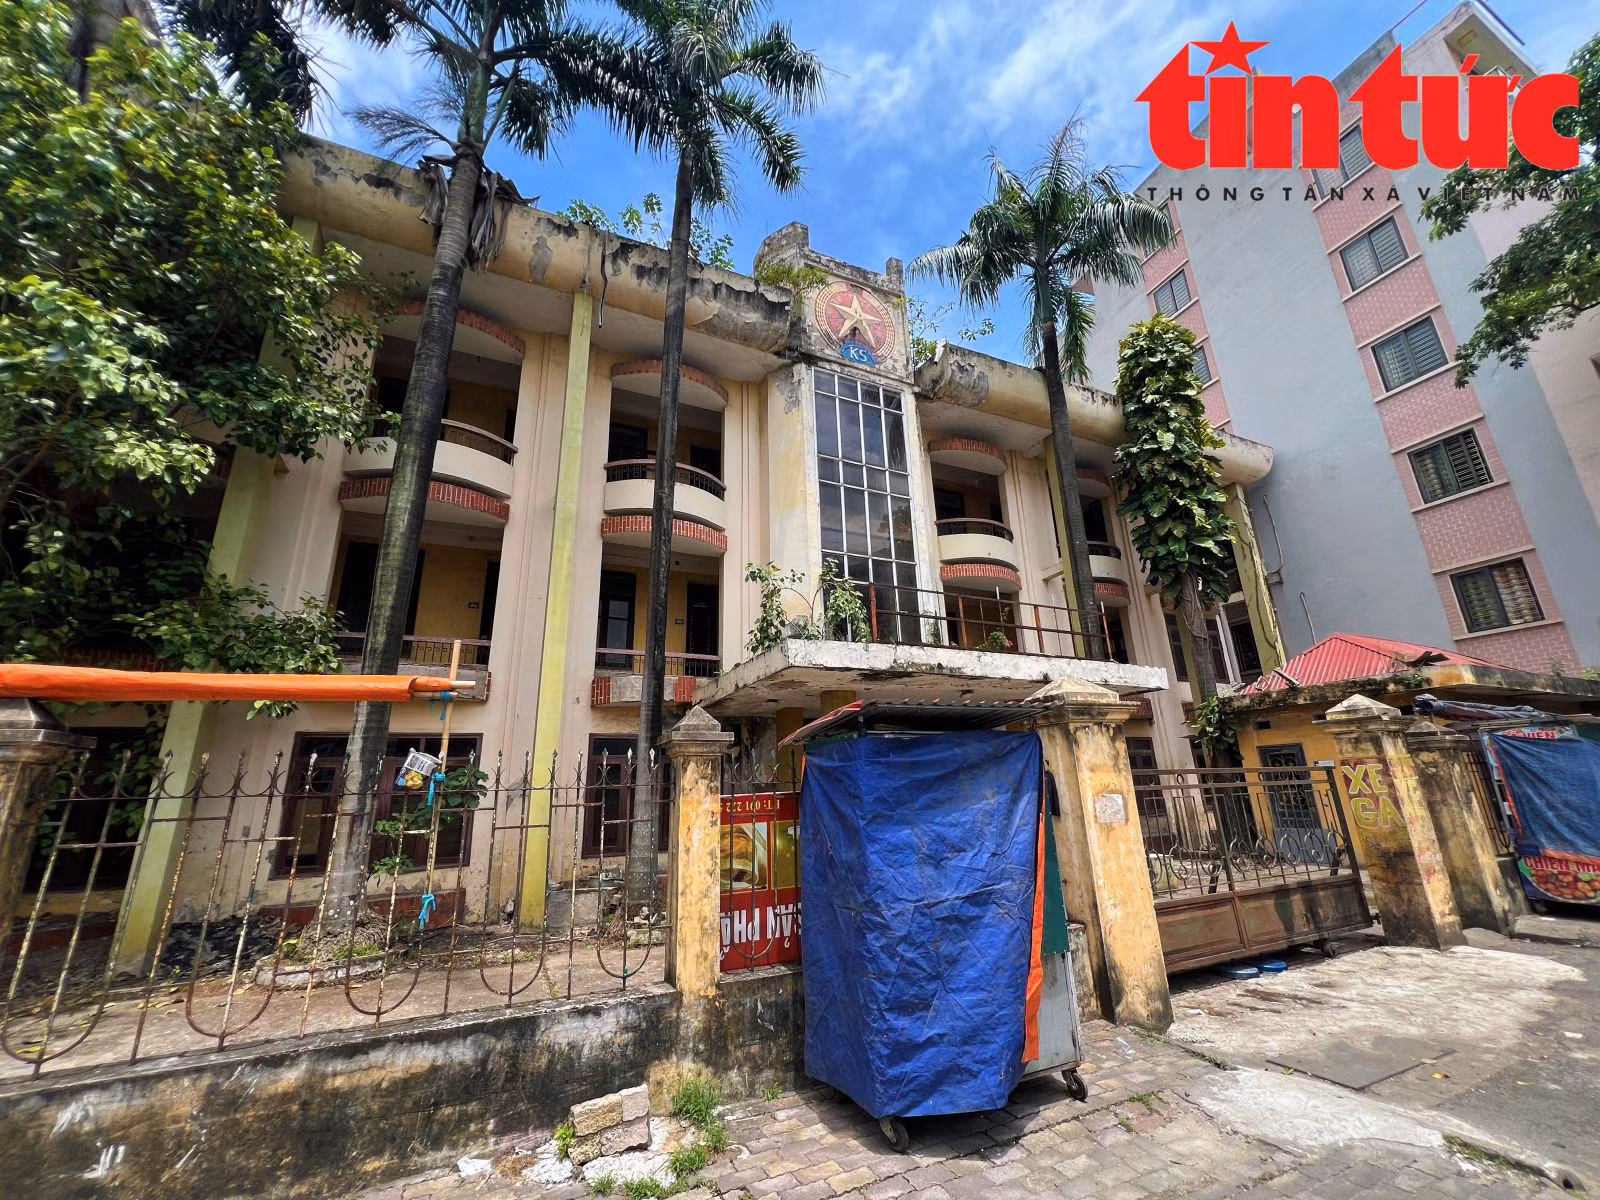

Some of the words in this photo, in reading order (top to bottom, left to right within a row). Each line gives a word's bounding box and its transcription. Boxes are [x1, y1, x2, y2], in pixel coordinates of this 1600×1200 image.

[850, 346, 867, 361] KS
[1341, 764, 1389, 795] XE
[1351, 796, 1406, 829] GA
